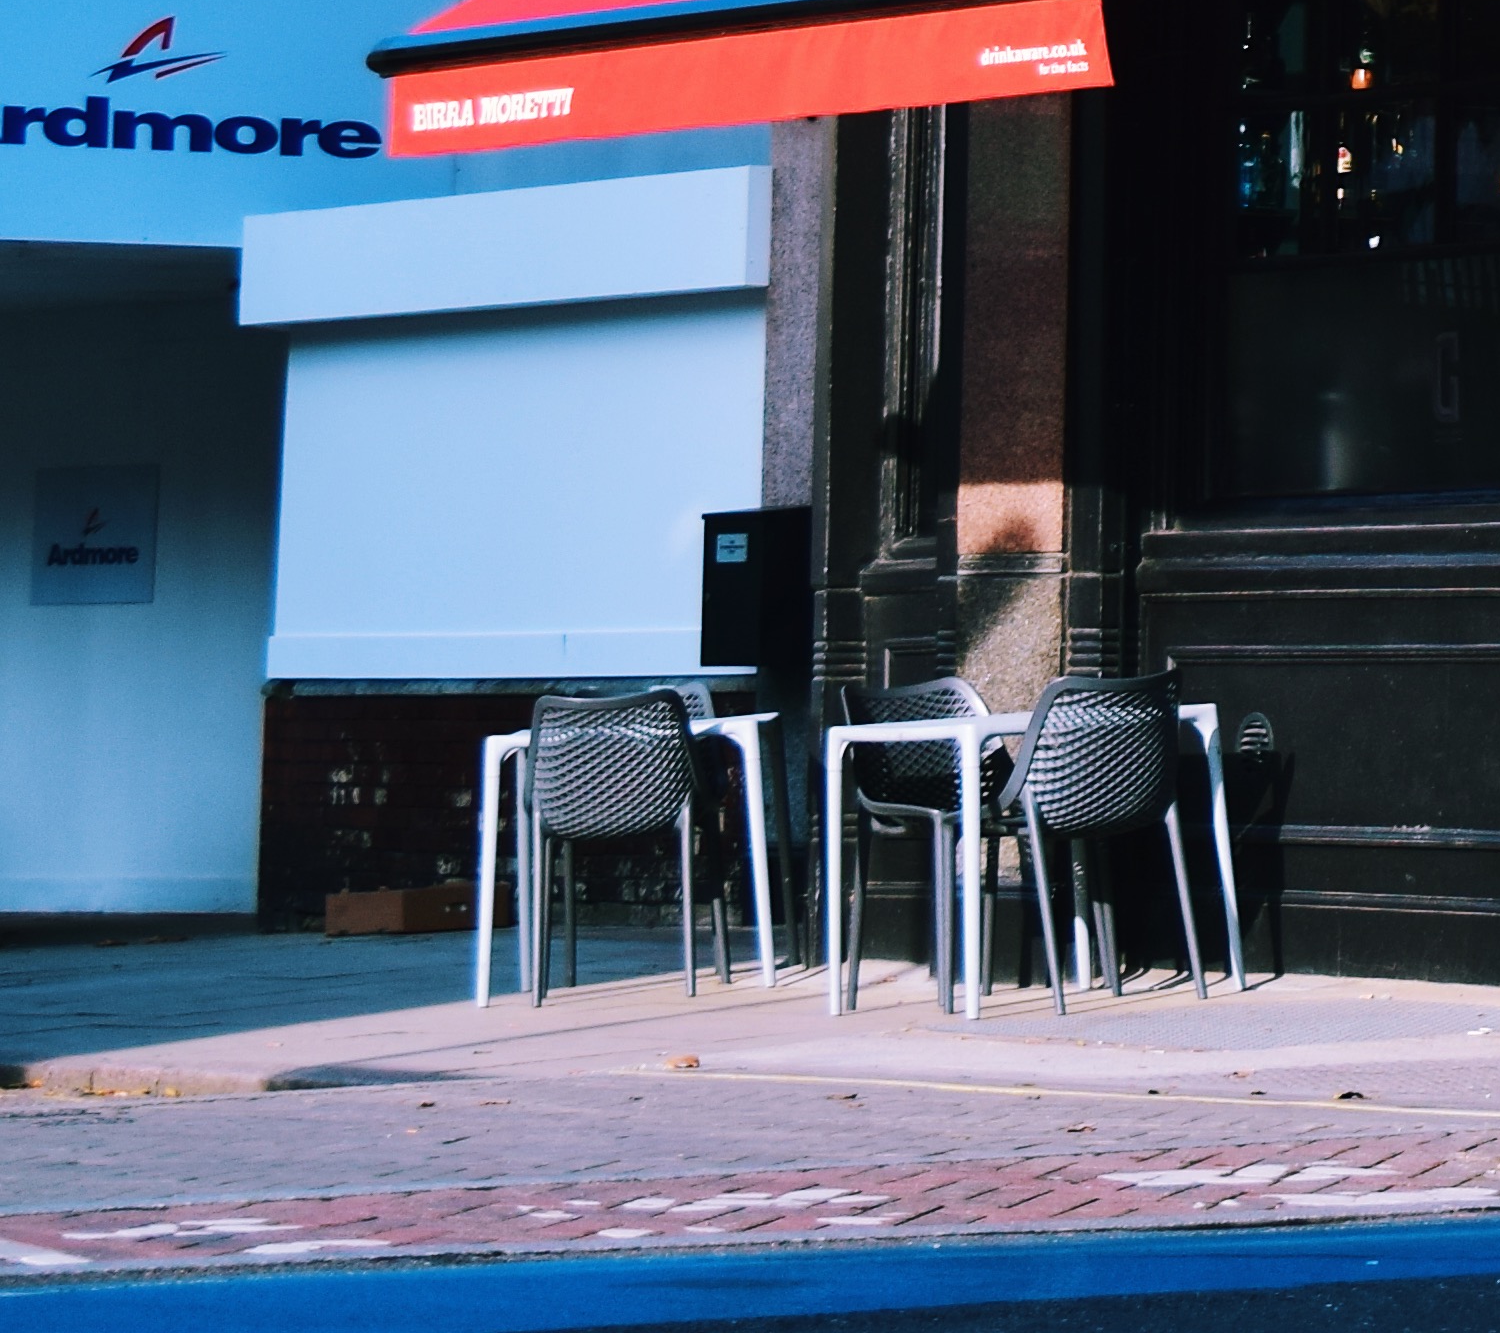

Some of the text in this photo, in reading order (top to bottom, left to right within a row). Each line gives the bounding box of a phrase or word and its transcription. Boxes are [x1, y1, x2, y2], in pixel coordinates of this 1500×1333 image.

[980, 39, 1087, 65] drinkaware.co.uk
[0, 96, 382, 158] rdmore
[412, 86, 575, 133] BIRRA MORETTI
[47, 543, 138, 567] Ardmore
